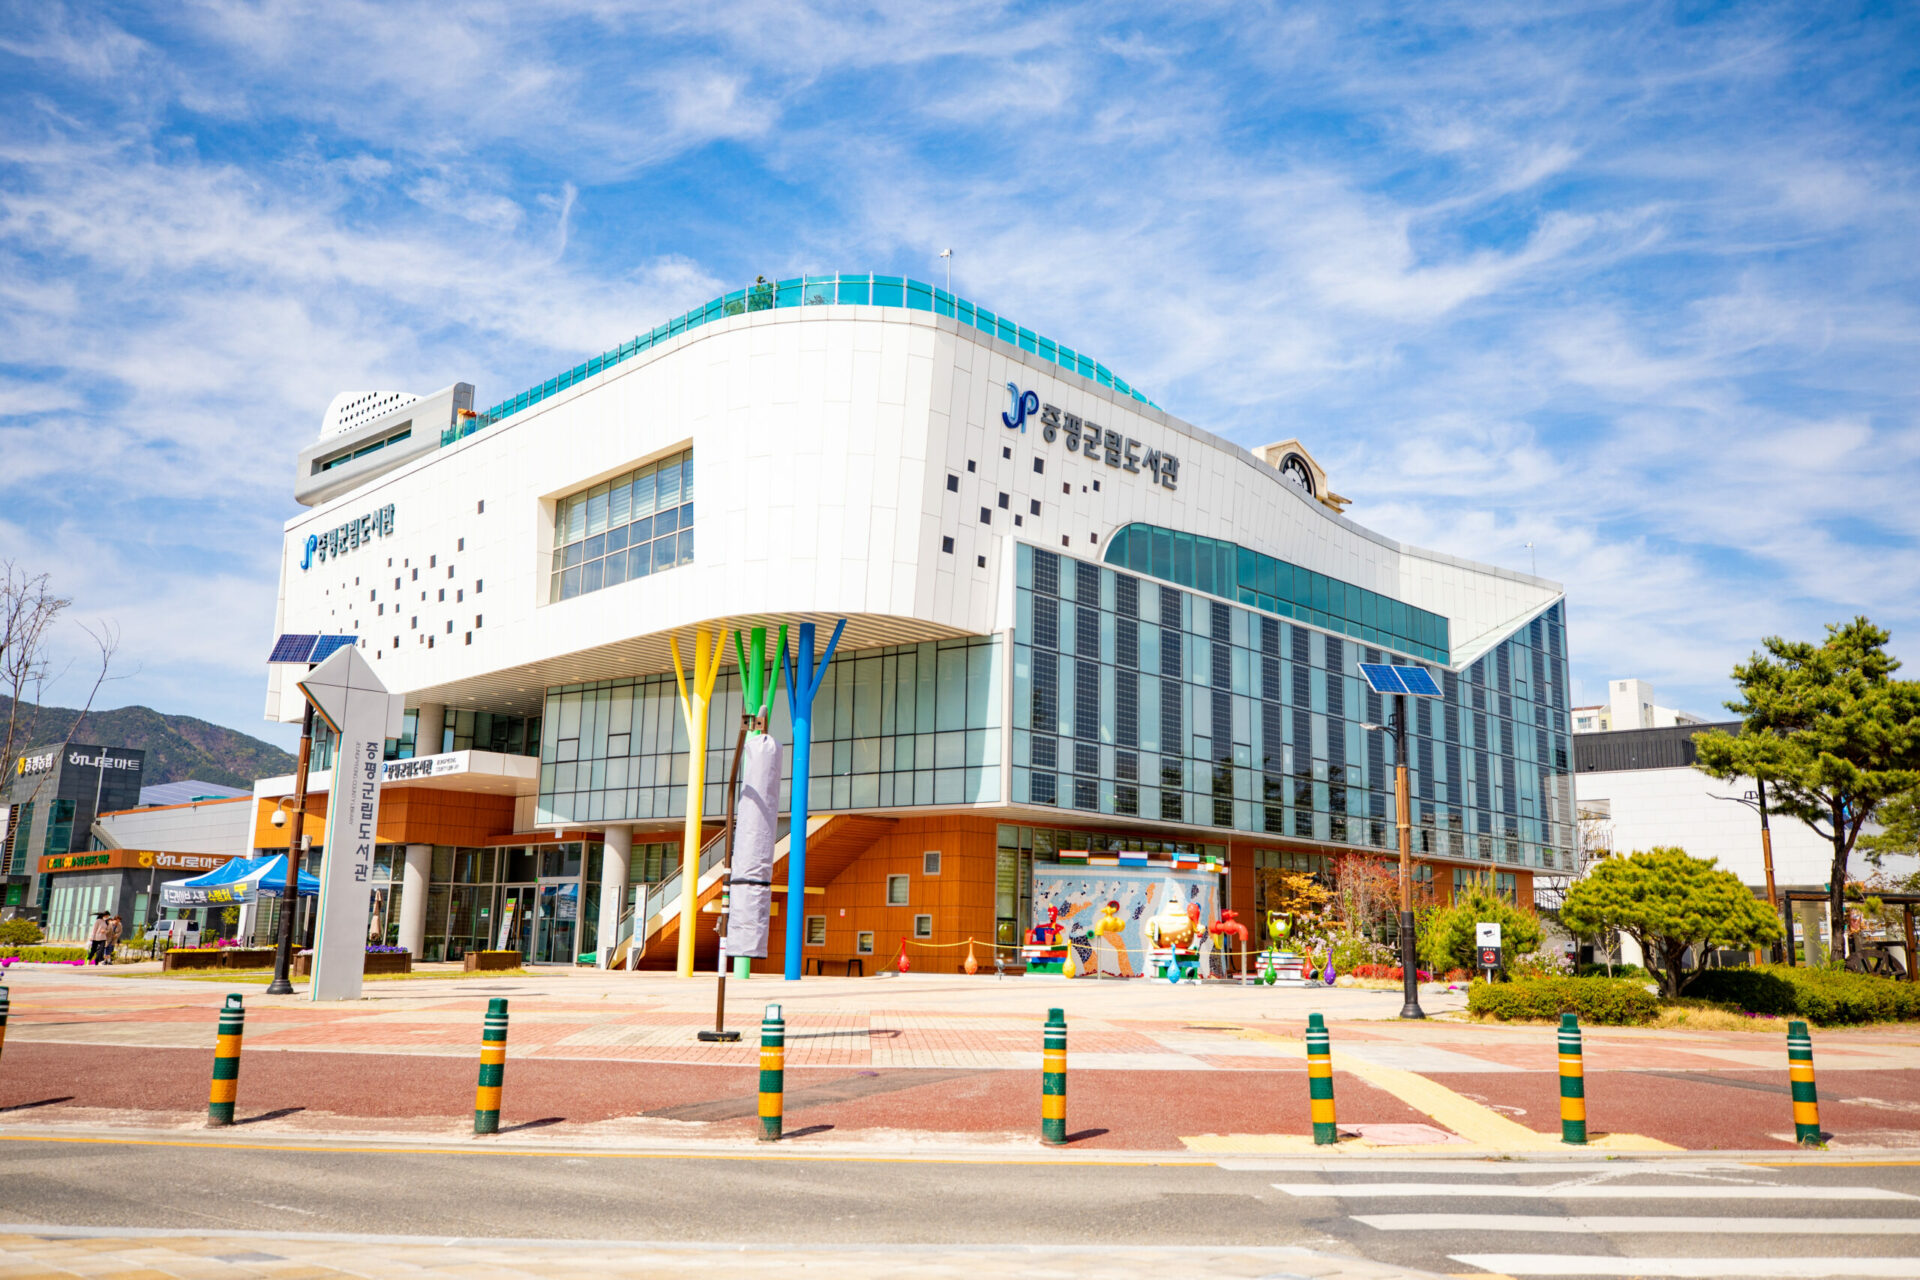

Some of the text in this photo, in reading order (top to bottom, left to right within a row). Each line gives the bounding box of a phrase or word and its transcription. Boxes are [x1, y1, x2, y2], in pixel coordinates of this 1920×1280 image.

[1040, 402, 1181, 491] 증평군립도서관
[318, 503, 394, 562] 증평군립도서관
[69, 751, 141, 771] 하나로마트
[355, 741, 379, 882] 증평군립도서관
[155, 852, 226, 870] 하나로마트
